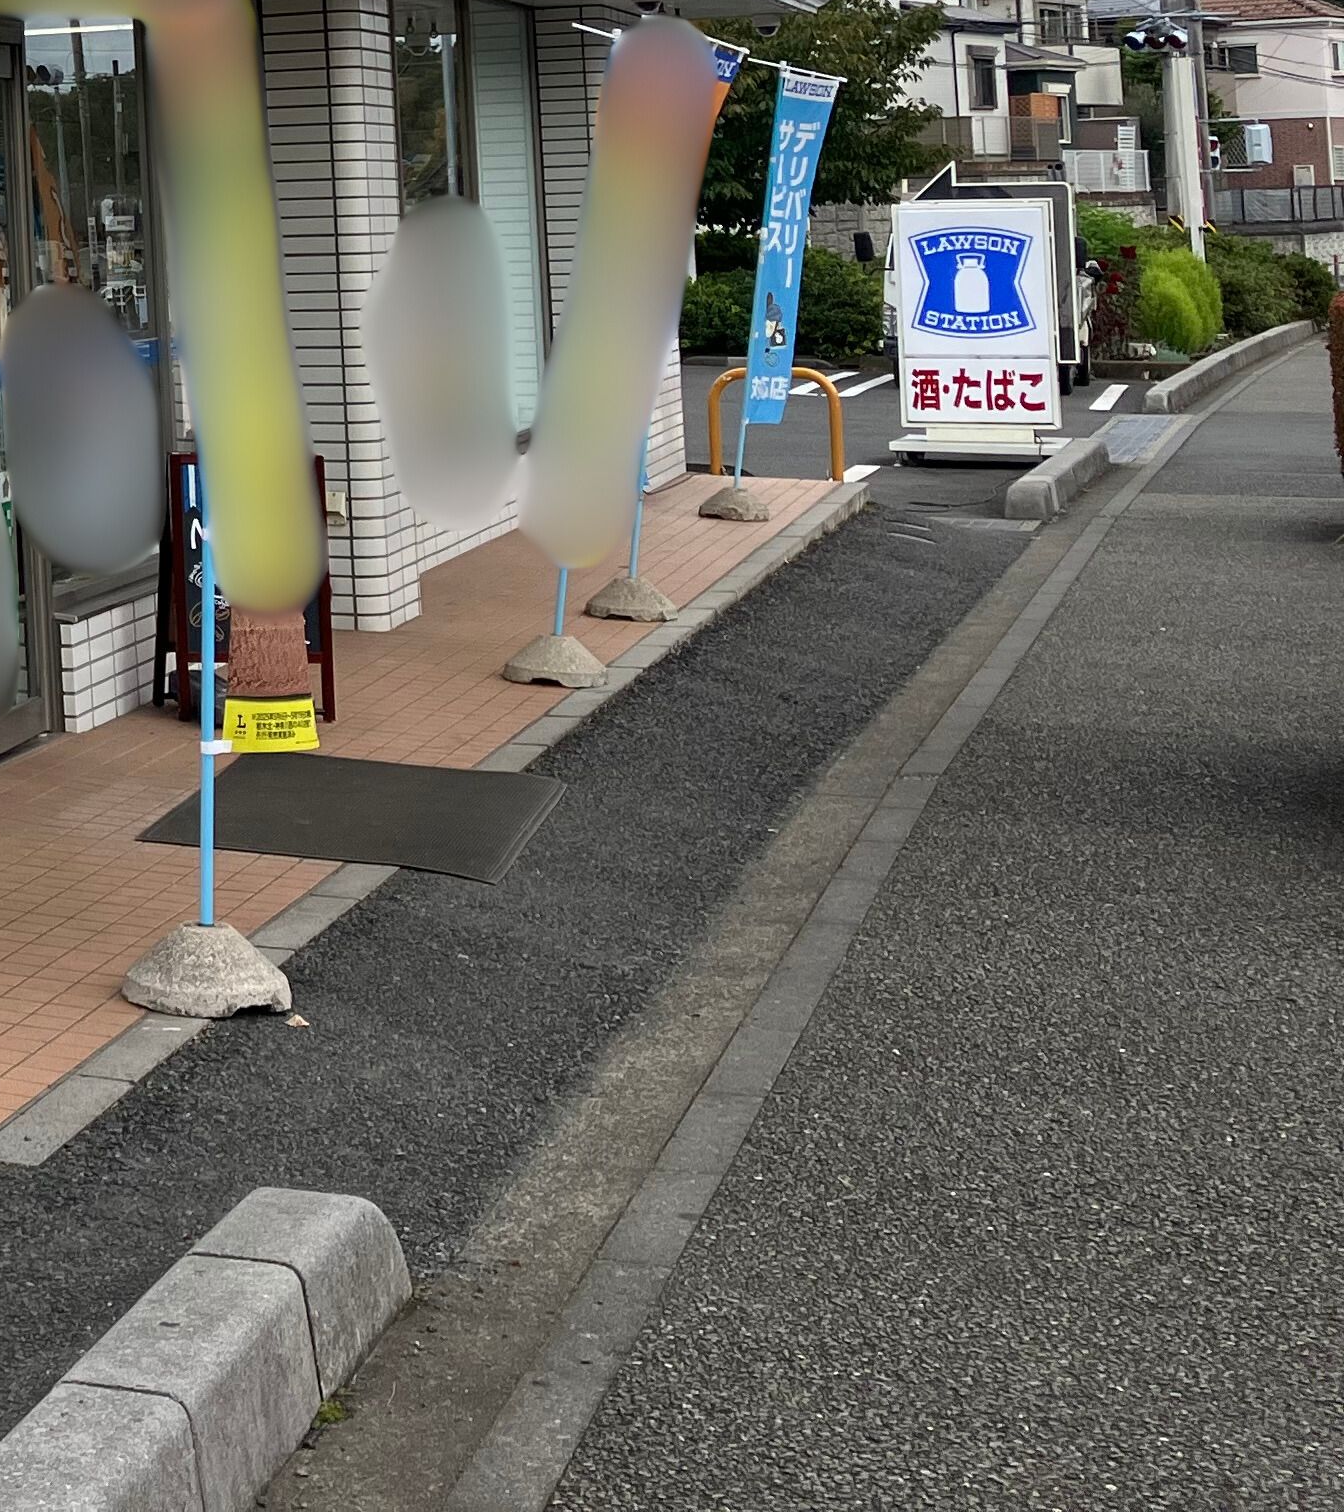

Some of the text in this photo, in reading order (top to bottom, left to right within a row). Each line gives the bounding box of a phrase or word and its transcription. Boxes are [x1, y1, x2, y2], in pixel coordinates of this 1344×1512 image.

[785, 79, 833, 98] LAWSON
[767, 119, 795, 252] サービス
[784, 120, 821, 288] デリバリー
[921, 235, 1020, 256] LAWSON
[924, 311, 1022, 331] STATION
[912, 368, 1046, 412] 酒・たばこ
